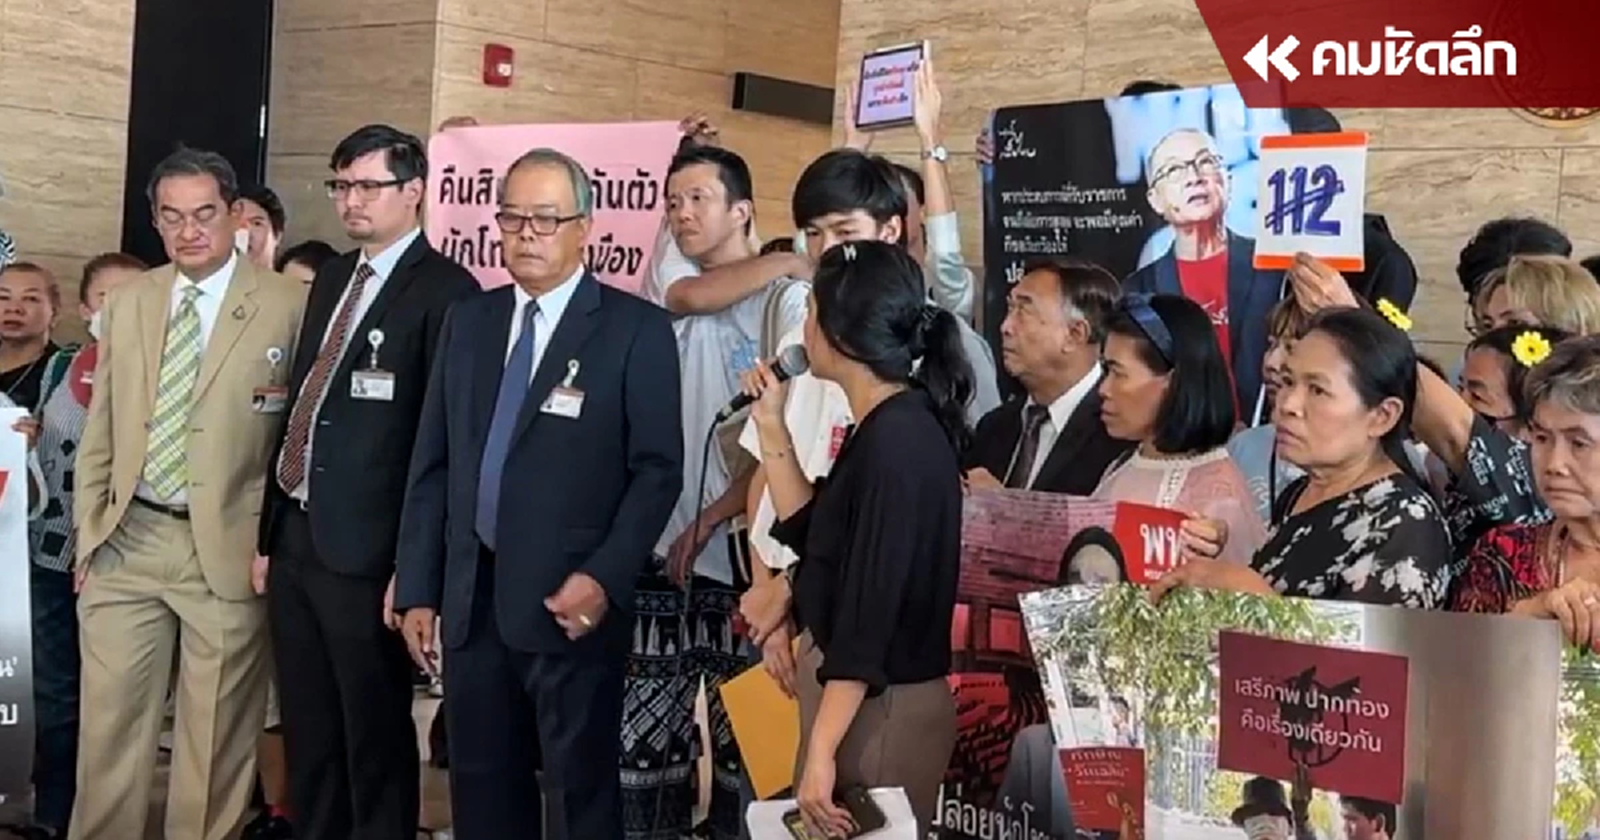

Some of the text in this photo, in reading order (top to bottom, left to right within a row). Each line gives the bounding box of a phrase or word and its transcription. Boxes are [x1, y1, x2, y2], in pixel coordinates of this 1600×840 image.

[438, 164, 502, 206] คืนสิ
[1264, 164, 1344, 236] 112
[1235, 677, 1389, 718] เสรีภาพ ปากท้อง
[1241, 708, 1383, 752] คือเรื่องเดียวกัน
